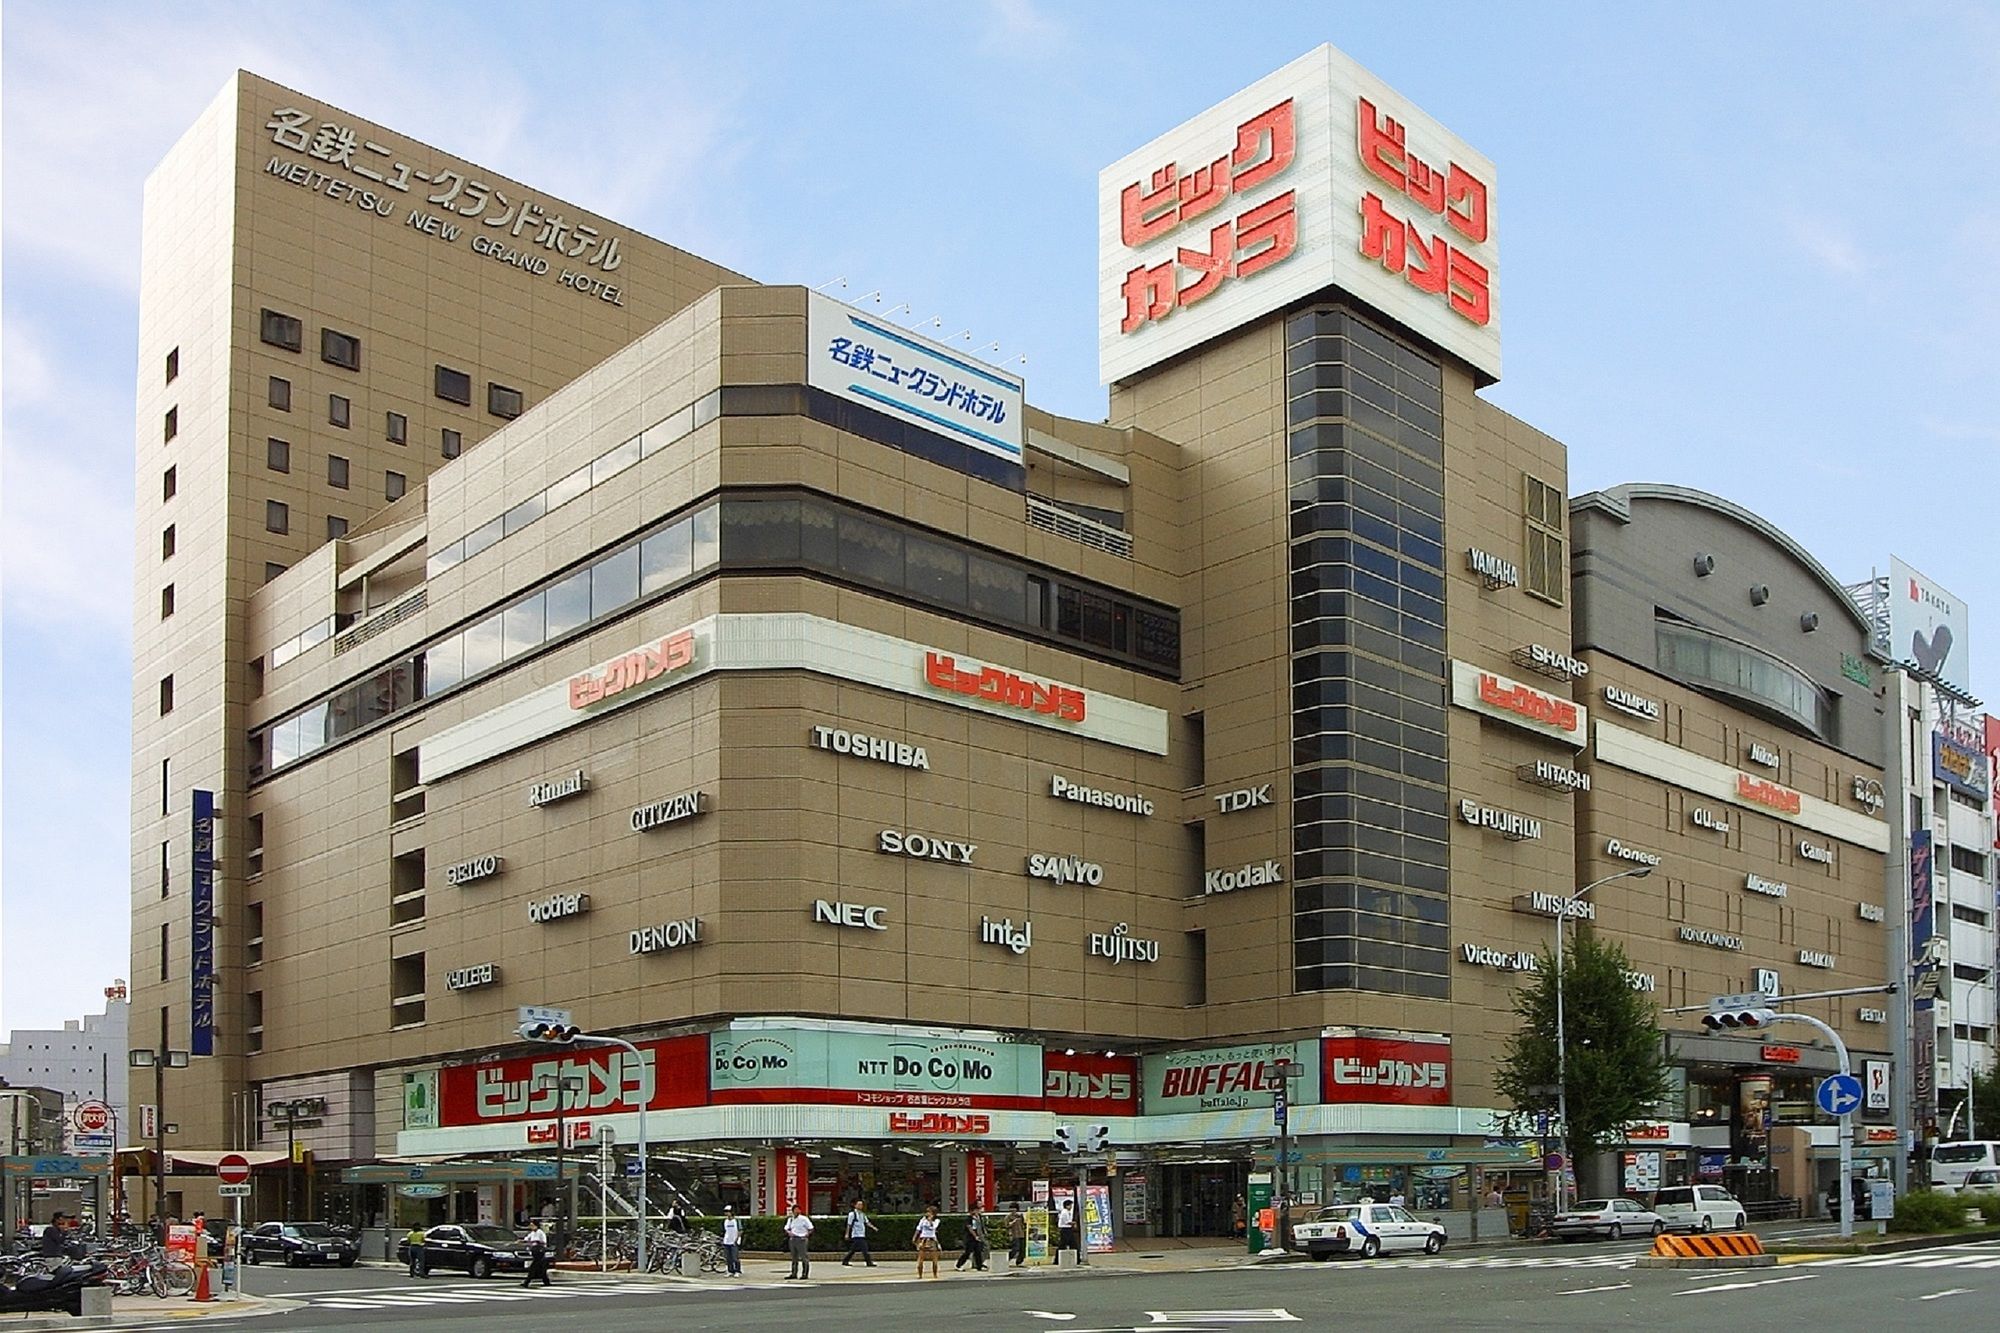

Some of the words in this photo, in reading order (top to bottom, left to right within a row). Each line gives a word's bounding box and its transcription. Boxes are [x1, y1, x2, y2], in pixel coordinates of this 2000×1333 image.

[1122, 97, 1295, 247] ビック
[1358, 96, 1487, 243] ビック
[265, 107, 623, 271] 名鉄ニューグランドホテル
[265, 157, 394, 217] MEITETSU
[406, 209, 462, 242] NEW
[471, 234, 550, 276] GRAND
[558, 268, 625, 307] HOTEL
[1121, 188, 1297, 335] カメラ
[1359, 190, 1491, 326] カメラ
[828, 337, 1006, 424] 名鉄ニューグランドホテル
[1470, 547, 1518, 588] YAMAHA
[569, 629, 694, 710] ビックカメラ
[1531, 644, 1590, 678] SHARP
[926, 650, 1086, 723] ビックカメラ
[1479, 673, 1577, 732] ビックカメラ
[1606, 685, 1659, 717] OLYMPUS
[814, 725, 930, 770] TOSHIBA
[1750, 743, 1780, 768] Nikon
[529, 769, 582, 806] Rinnai
[1537, 760, 1590, 792] HITACHI
[630, 791, 700, 832] CITIZEN
[1052, 774, 1155, 816] Panasonic
[1213, 783, 1271, 814] TDK
[1481, 808, 1542, 840] FUJIFILM
[880, 830, 978, 864] SONY
[1607, 839, 1662, 866] Pioneer
[1801, 840, 1833, 864] Canon
[446, 856, 496, 886] SEIKO
[1029, 853, 1103, 886] SANYO
[1205, 860, 1283, 894] Kodak
[527, 892, 583, 923] brother
[815, 900, 888, 931] NEC
[1532, 891, 1596, 920] MITSUBISHI
[629, 917, 699, 954] DENON
[981, 916, 1032, 954] intel
[1090, 922, 1160, 965] FUJITSU
[1800, 950, 1836, 969] DAIKIN
[1619, 967, 1655, 992] PSON
[1860, 1007, 1887, 1024] PENTAX
[476, 1048, 657, 1118] ビックカメラ
[858, 1060, 889, 1075] NTT
[1046, 1069, 1131, 1100] クカメラ
[1334, 1058, 1447, 1088] ビックカメラ
[1200, 1096, 1249, 1109] buffalo.jp
[889, 1112, 991, 1135] ビックカメラ
